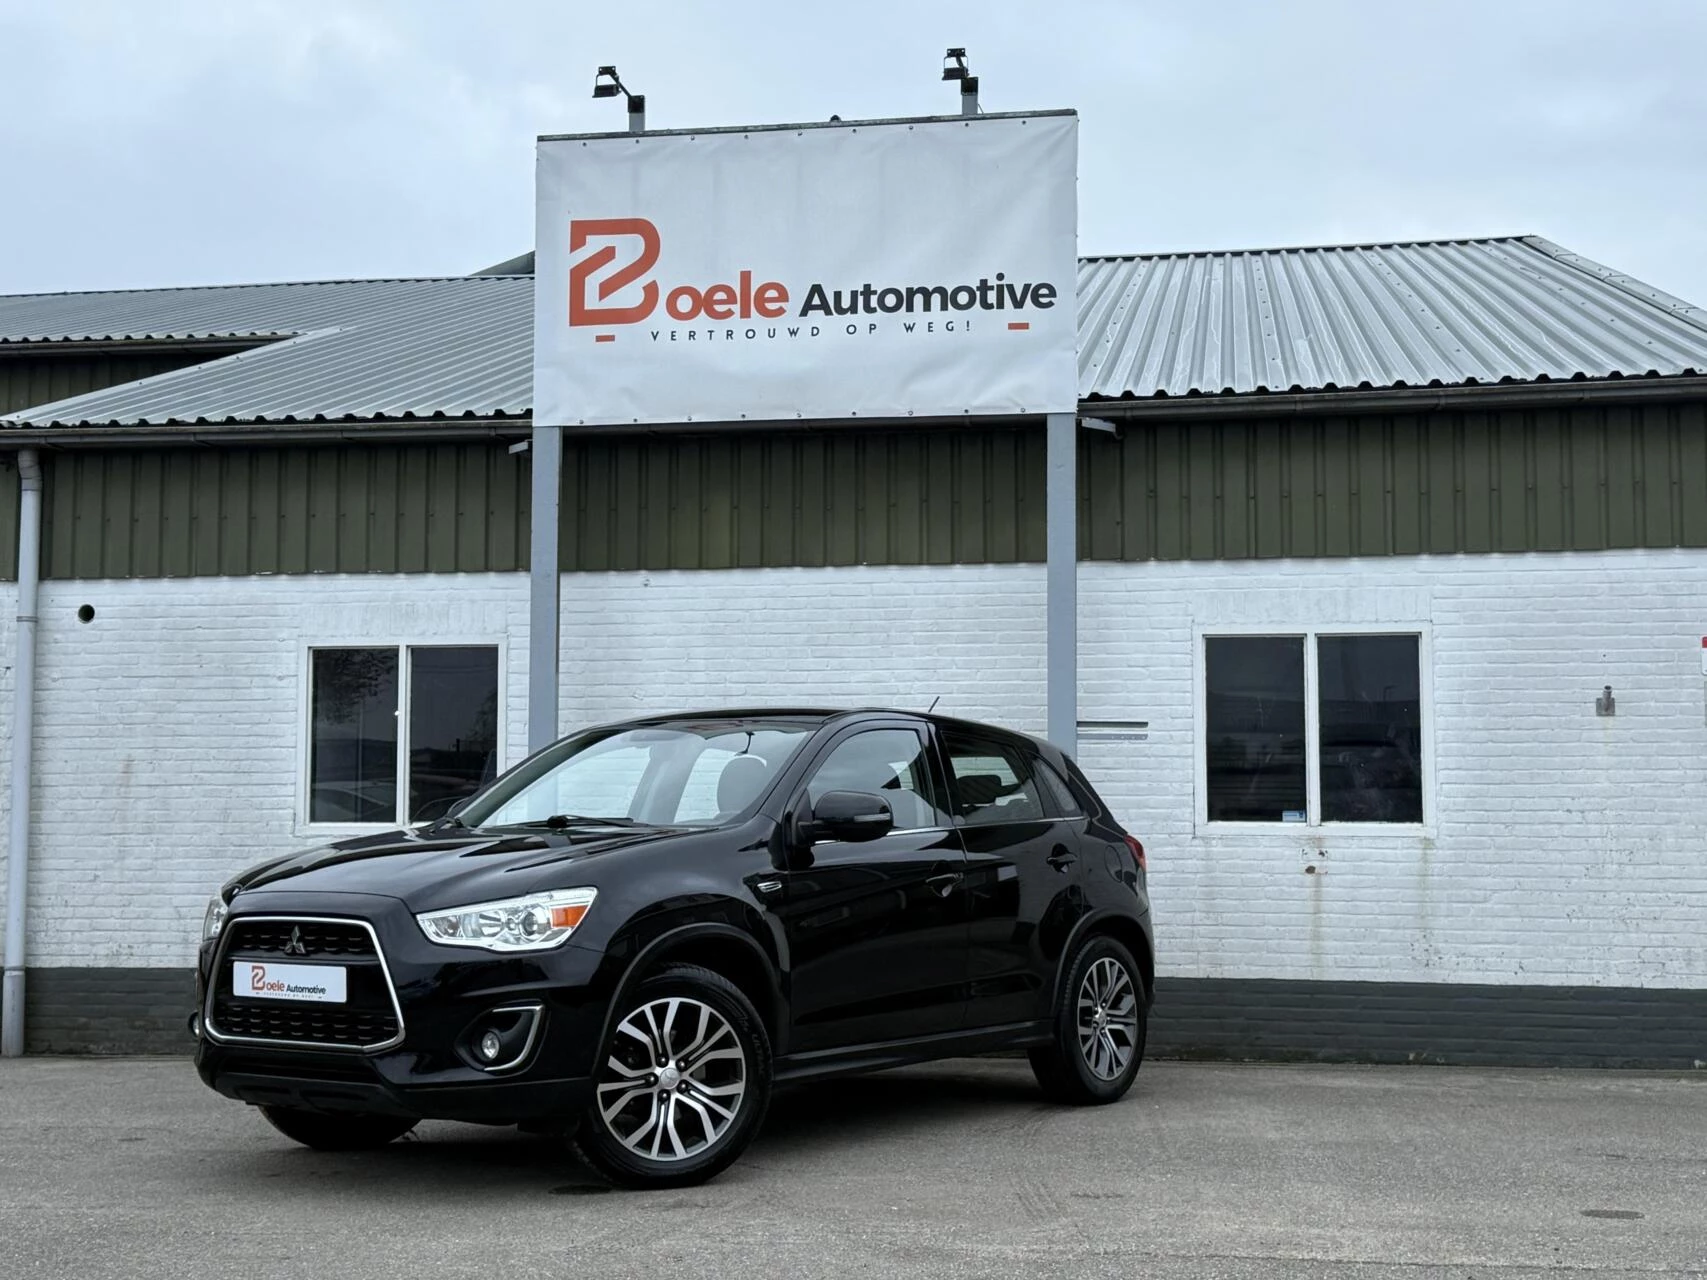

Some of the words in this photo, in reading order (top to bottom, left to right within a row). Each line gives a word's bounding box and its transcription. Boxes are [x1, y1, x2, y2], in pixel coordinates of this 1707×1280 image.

[569, 217, 790, 326] Boele
[798, 272, 1057, 318] Automotive
[650, 326, 821, 342] VERTROUWD
[846, 323, 877, 336] OP
[903, 320, 972, 333] WEG!
[286, 984, 326, 995] Automotive
